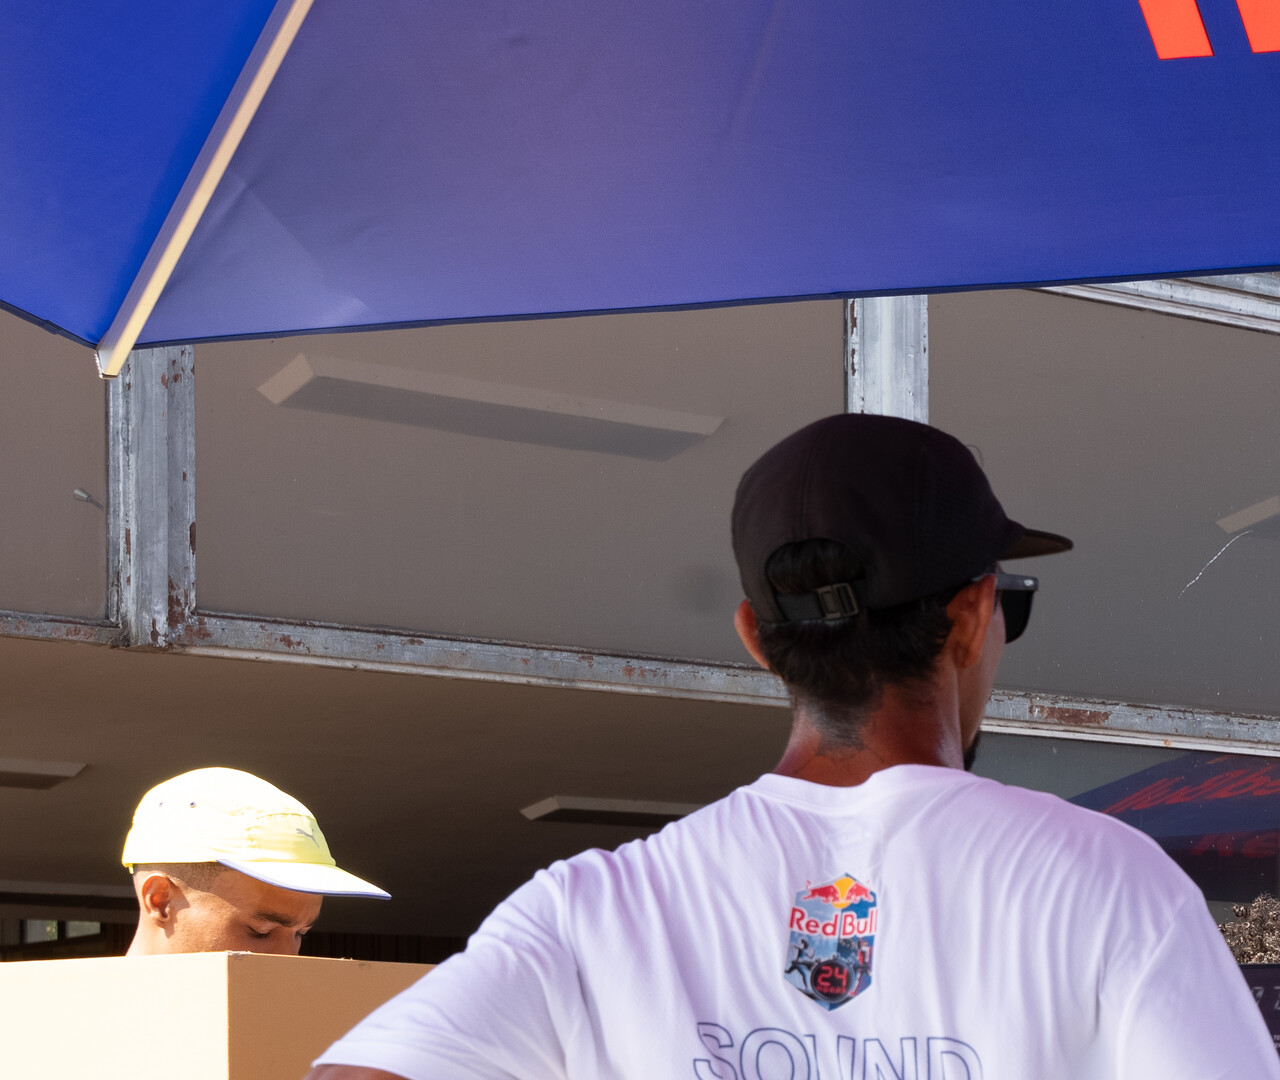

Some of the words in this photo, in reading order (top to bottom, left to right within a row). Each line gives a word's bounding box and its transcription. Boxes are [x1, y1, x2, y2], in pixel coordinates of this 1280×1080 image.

[789, 907, 838, 936] Red
[842, 909, 878, 937] Bull
[817, 965, 848, 986] 24
